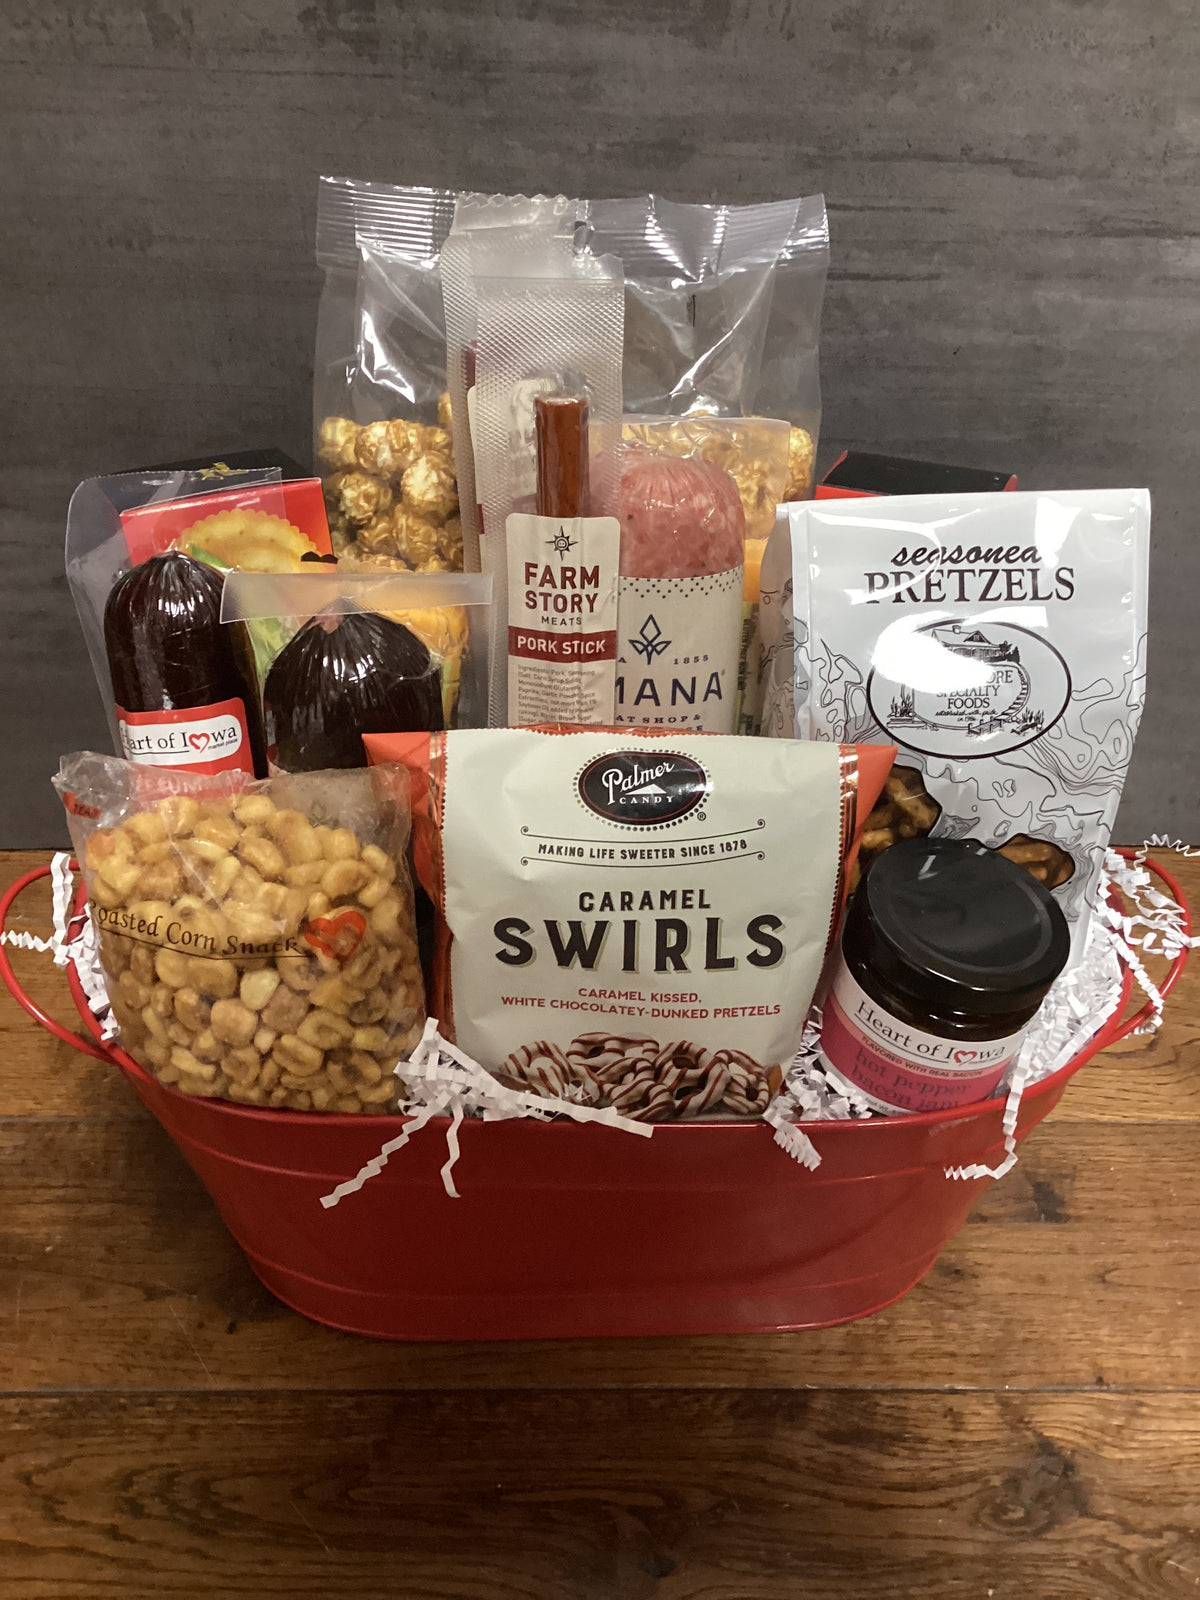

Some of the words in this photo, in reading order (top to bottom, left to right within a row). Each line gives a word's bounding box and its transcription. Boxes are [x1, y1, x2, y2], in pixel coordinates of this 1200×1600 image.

[524, 562, 600, 589] FARM
[864, 567, 1075, 604] PRETZELS
[525, 590, 599, 613] STORY
[541, 616, 582, 626] MEATS
[517, 636, 558, 654] PORK
[562, 639, 606, 655] STICK
[673, 655, 709, 665] 1855
[615, 672, 722, 707] ANA
[947, 697, 990, 709] FOODS
[157, 733, 176, 749] of
[601, 762, 676, 805] Palmer
[619, 795, 674, 804] CANDY
[538, 843, 584, 857] MAKING
[590, 847, 615, 860] LIFE
[620, 848, 675, 860] SWEETER
[681, 844, 715, 857] SINCE
[720, 839, 747, 853] 1878
[578, 889, 711, 912] CARAMEL
[166, 922, 216, 951] Corn
[222, 935, 301, 956] Snack
[493, 914, 788, 974] SWIRLS
[501, 996, 546, 1009] WHITE
[550, 999, 709, 1019] CHOCOLATEY-DUNKED
[713, 1004, 781, 1019] PRETZELS
[577, 988, 646, 1001] CARAMEL
[650, 992, 702, 1004] KISSED,
[857, 1000, 912, 1046] Heart
[917, 1043, 942, 1057] of
[862, 1036, 902, 1065] FLAVORED
[905, 1062, 927, 1073] WITH
[929, 1069, 950, 1077] REAL
[856, 1047, 887, 1078] hot
[893, 1075, 972, 1097] pepper
[851, 1064, 911, 1106] bacon
